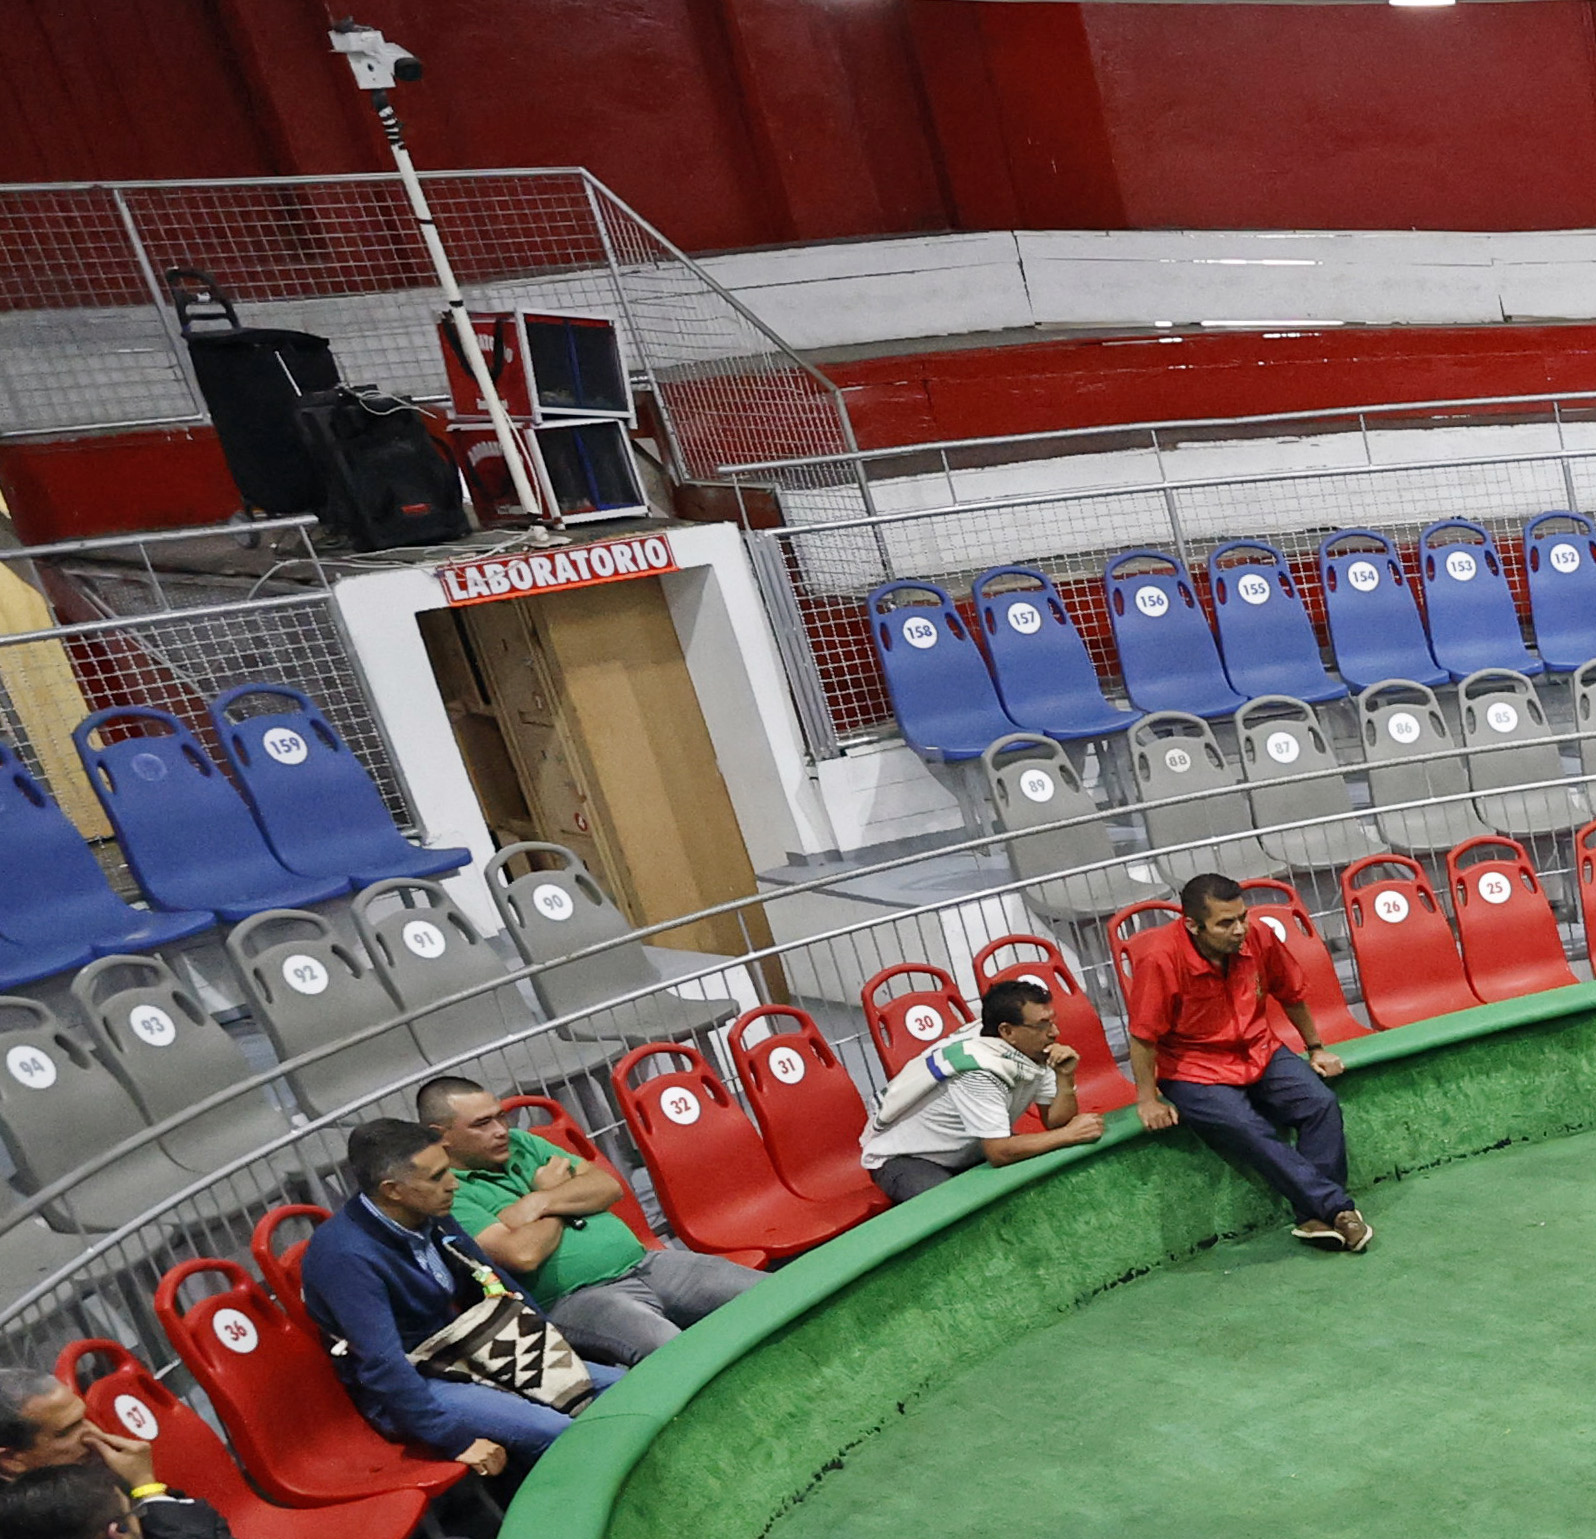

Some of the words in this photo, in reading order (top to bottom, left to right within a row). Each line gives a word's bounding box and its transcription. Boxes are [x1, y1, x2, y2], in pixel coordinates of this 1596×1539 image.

[1554, 551, 1576, 564] 152
[443, 537, 670, 602] LABORATORIO
[1450, 560, 1473, 573] 153
[1352, 570, 1376, 583] 154
[1243, 582, 1267, 596] 155
[1140, 594, 1165, 608] 156
[1012, 610, 1035, 626] 157
[906, 624, 933, 640] 158
[1494, 711, 1511, 724] 85
[1395, 722, 1413, 735] 86
[269, 736, 301, 755] 159
[1274, 740, 1290, 755] 87
[1168, 754, 1188, 767] 88
[1028, 778, 1046, 793] 89
[1486, 881, 1504, 895] 25
[542, 894, 564, 911] 90
[1383, 900, 1401, 914] 26
[413, 931, 435, 949] 91
[293, 965, 319, 983] 92
[140, 1016, 165, 1035] 93
[914, 1015, 935, 1032] 30
[18, 1057, 45, 1077] 94
[777, 1057, 796, 1075] 31
[670, 1096, 692, 1115] 32
[224, 1320, 248, 1342] 36
[126, 1406, 146, 1429] 37
